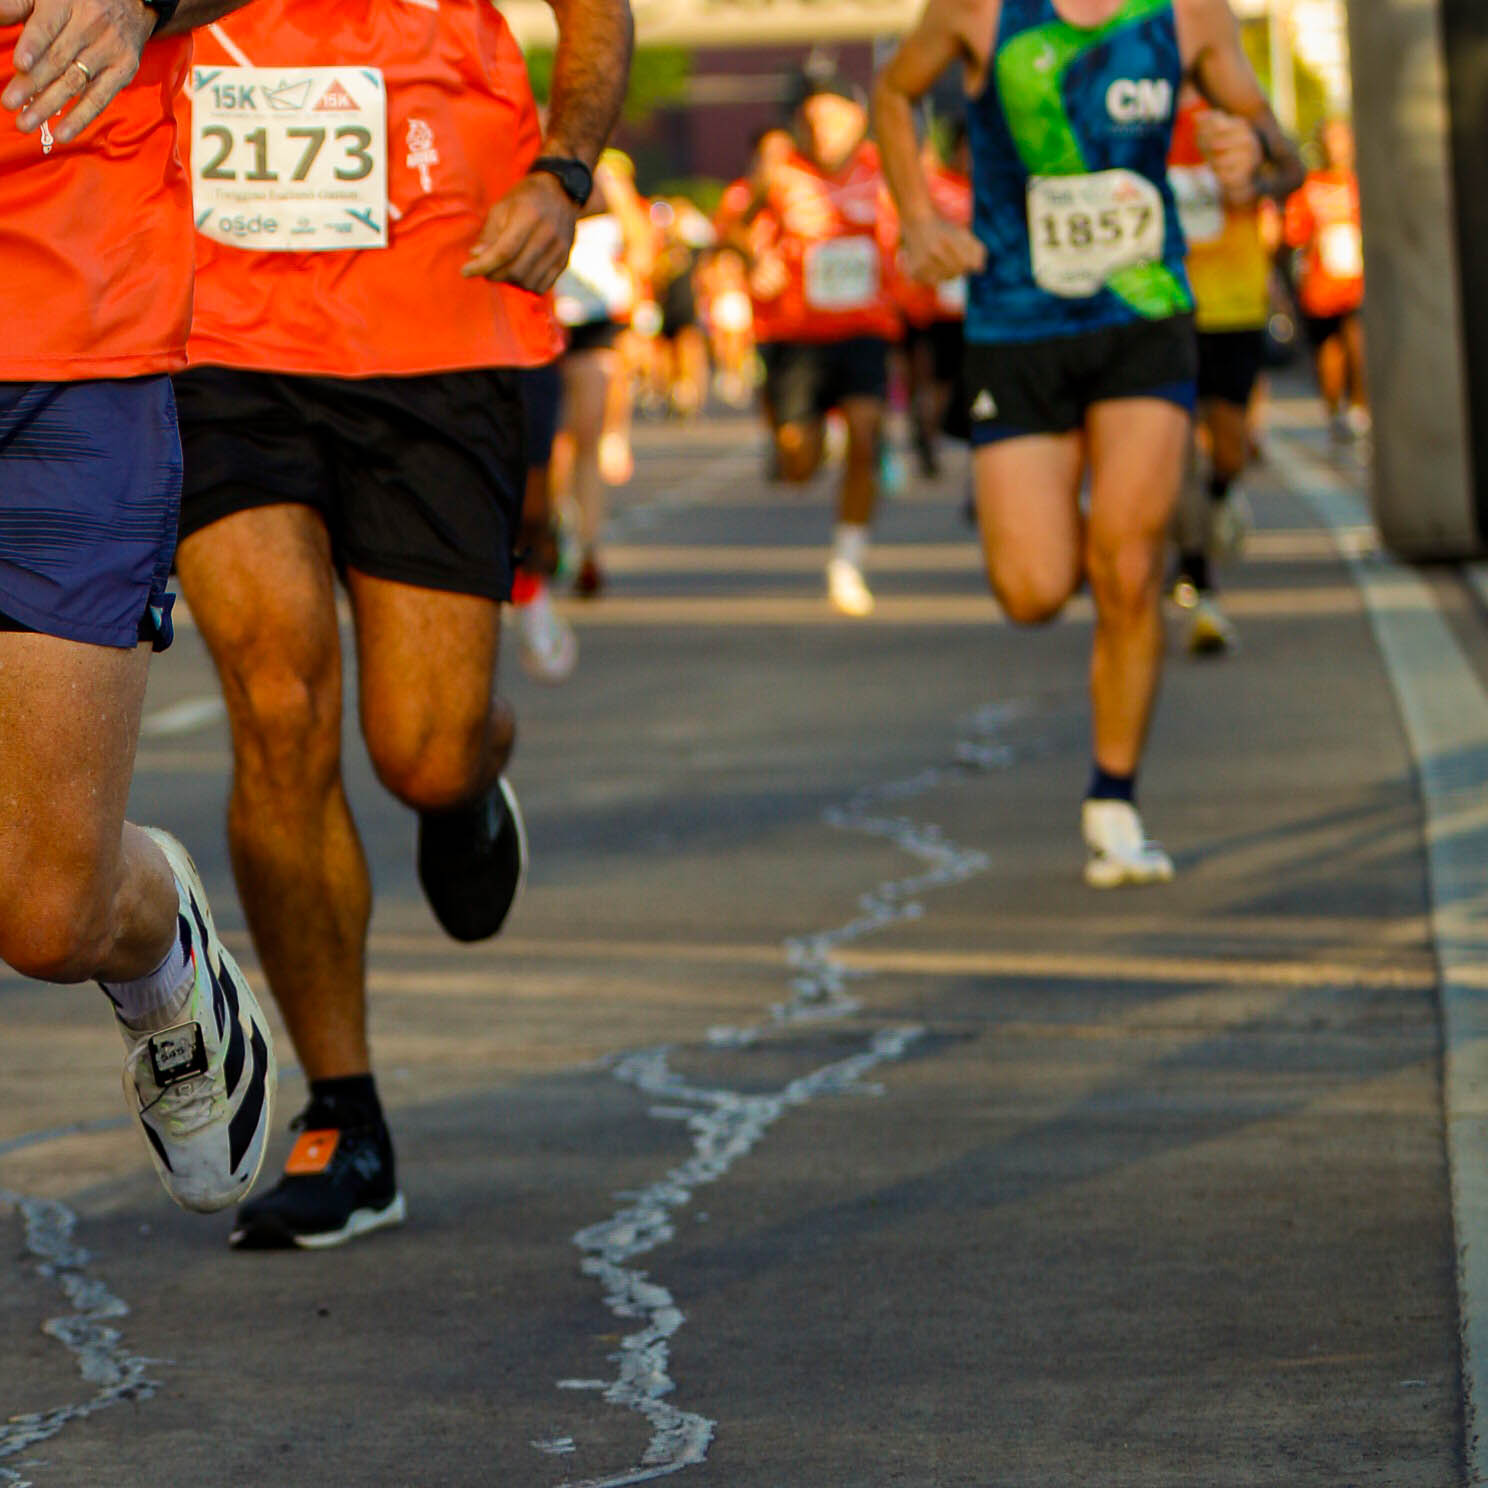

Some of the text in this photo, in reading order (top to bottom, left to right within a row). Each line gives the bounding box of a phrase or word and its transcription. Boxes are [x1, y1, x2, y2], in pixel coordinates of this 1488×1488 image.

[212, 84, 258, 110] 15K
[200, 124, 374, 182] 2173
[219, 213, 278, 237] osde
[1041, 205, 1154, 250] 1857
